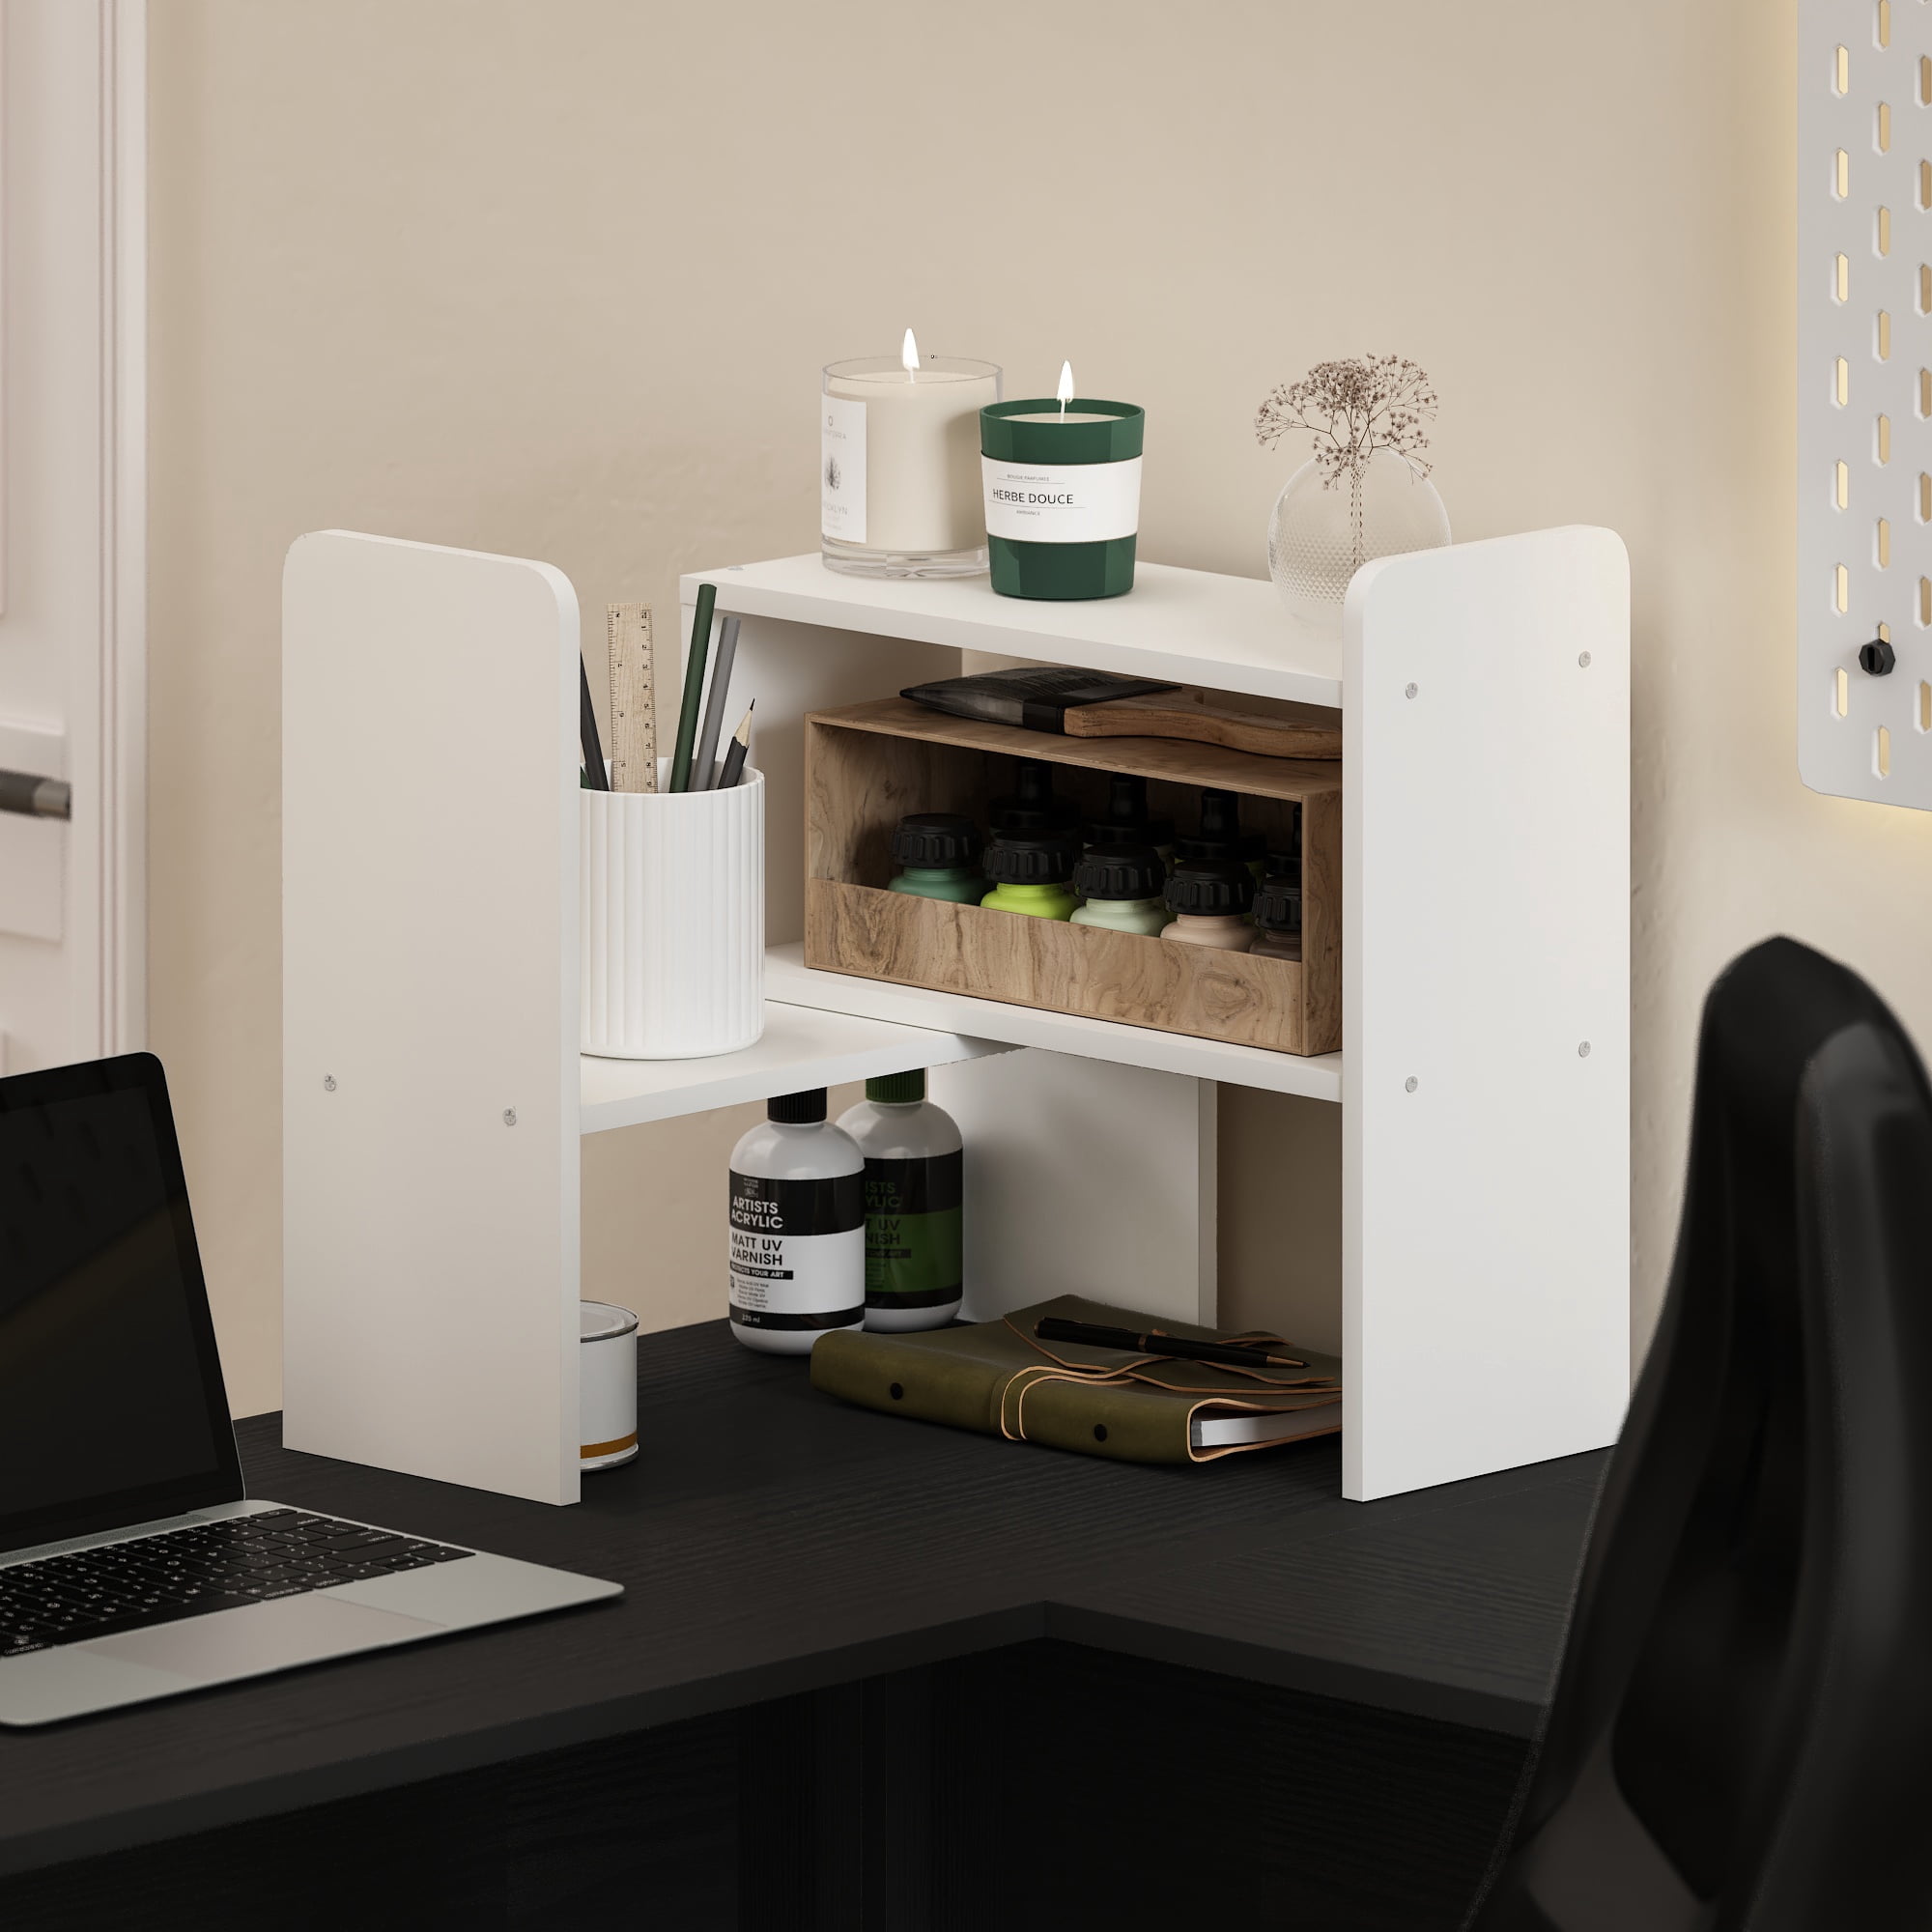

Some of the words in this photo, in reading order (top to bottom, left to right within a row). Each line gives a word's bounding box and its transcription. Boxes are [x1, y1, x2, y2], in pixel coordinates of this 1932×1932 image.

[993, 488, 1026, 503] HERBE
[1029, 494, 1074, 504] DOUCE
[866, 1180, 896, 1194] ISTS
[732, 1195, 779, 1214] ARTISTS
[866, 1195, 901, 1208] YLIC
[731, 1209, 783, 1229] ACRYLIC
[731, 1232, 757, 1249] MATT
[761, 1238, 782, 1252] UV
[866, 1233, 900, 1245] NISH
[731, 1245, 782, 1265] VARNISH
[751, 1267, 769, 1277] YOUR
